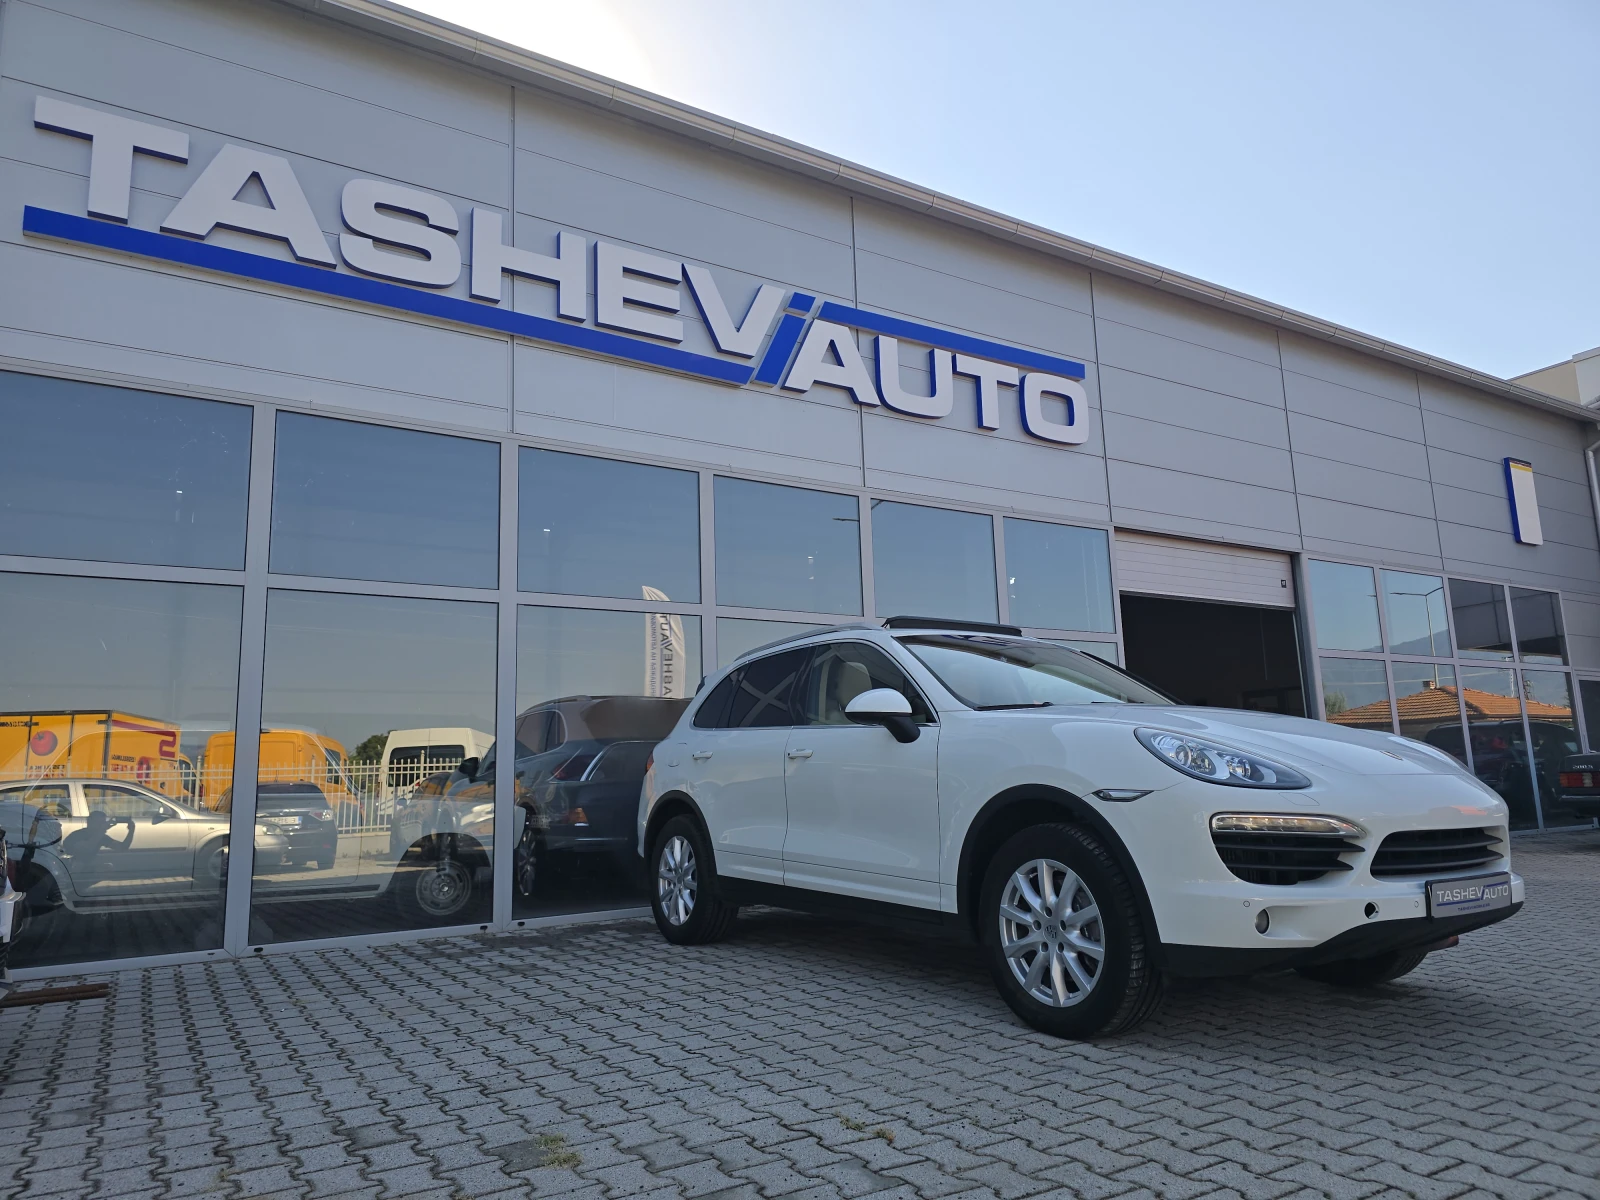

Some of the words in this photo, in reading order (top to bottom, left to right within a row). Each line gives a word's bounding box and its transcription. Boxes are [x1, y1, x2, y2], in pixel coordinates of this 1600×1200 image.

[34, 95, 786, 358] TASHEV
[781, 318, 1090, 445] AUTO
[1436, 886, 1484, 902] TASHEV
[1483, 885, 1509, 900] AUTO
